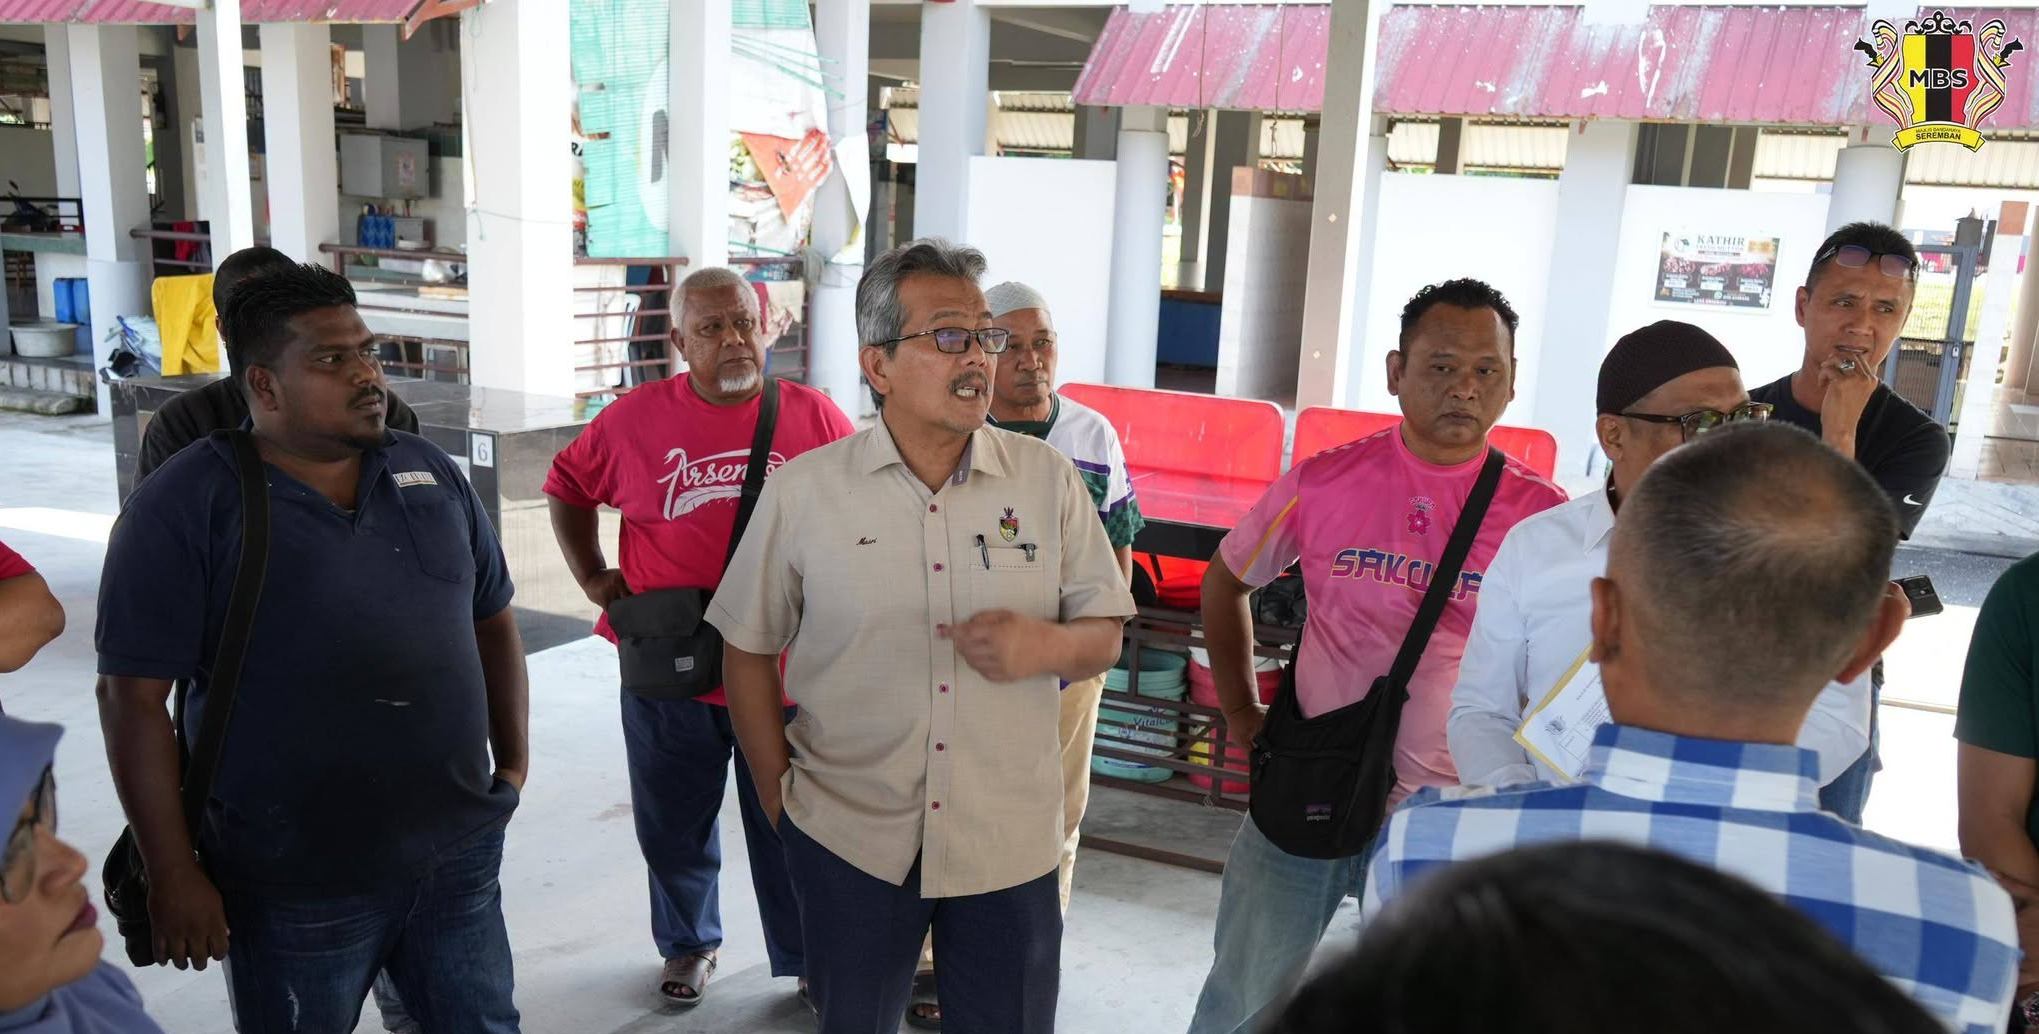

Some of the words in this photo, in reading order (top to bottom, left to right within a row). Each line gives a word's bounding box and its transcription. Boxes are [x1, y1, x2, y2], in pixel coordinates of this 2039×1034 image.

[1697, 235, 1745, 246] KATHIR
[477, 443, 488, 462] 6
[1331, 547, 1483, 601] SAKUA
